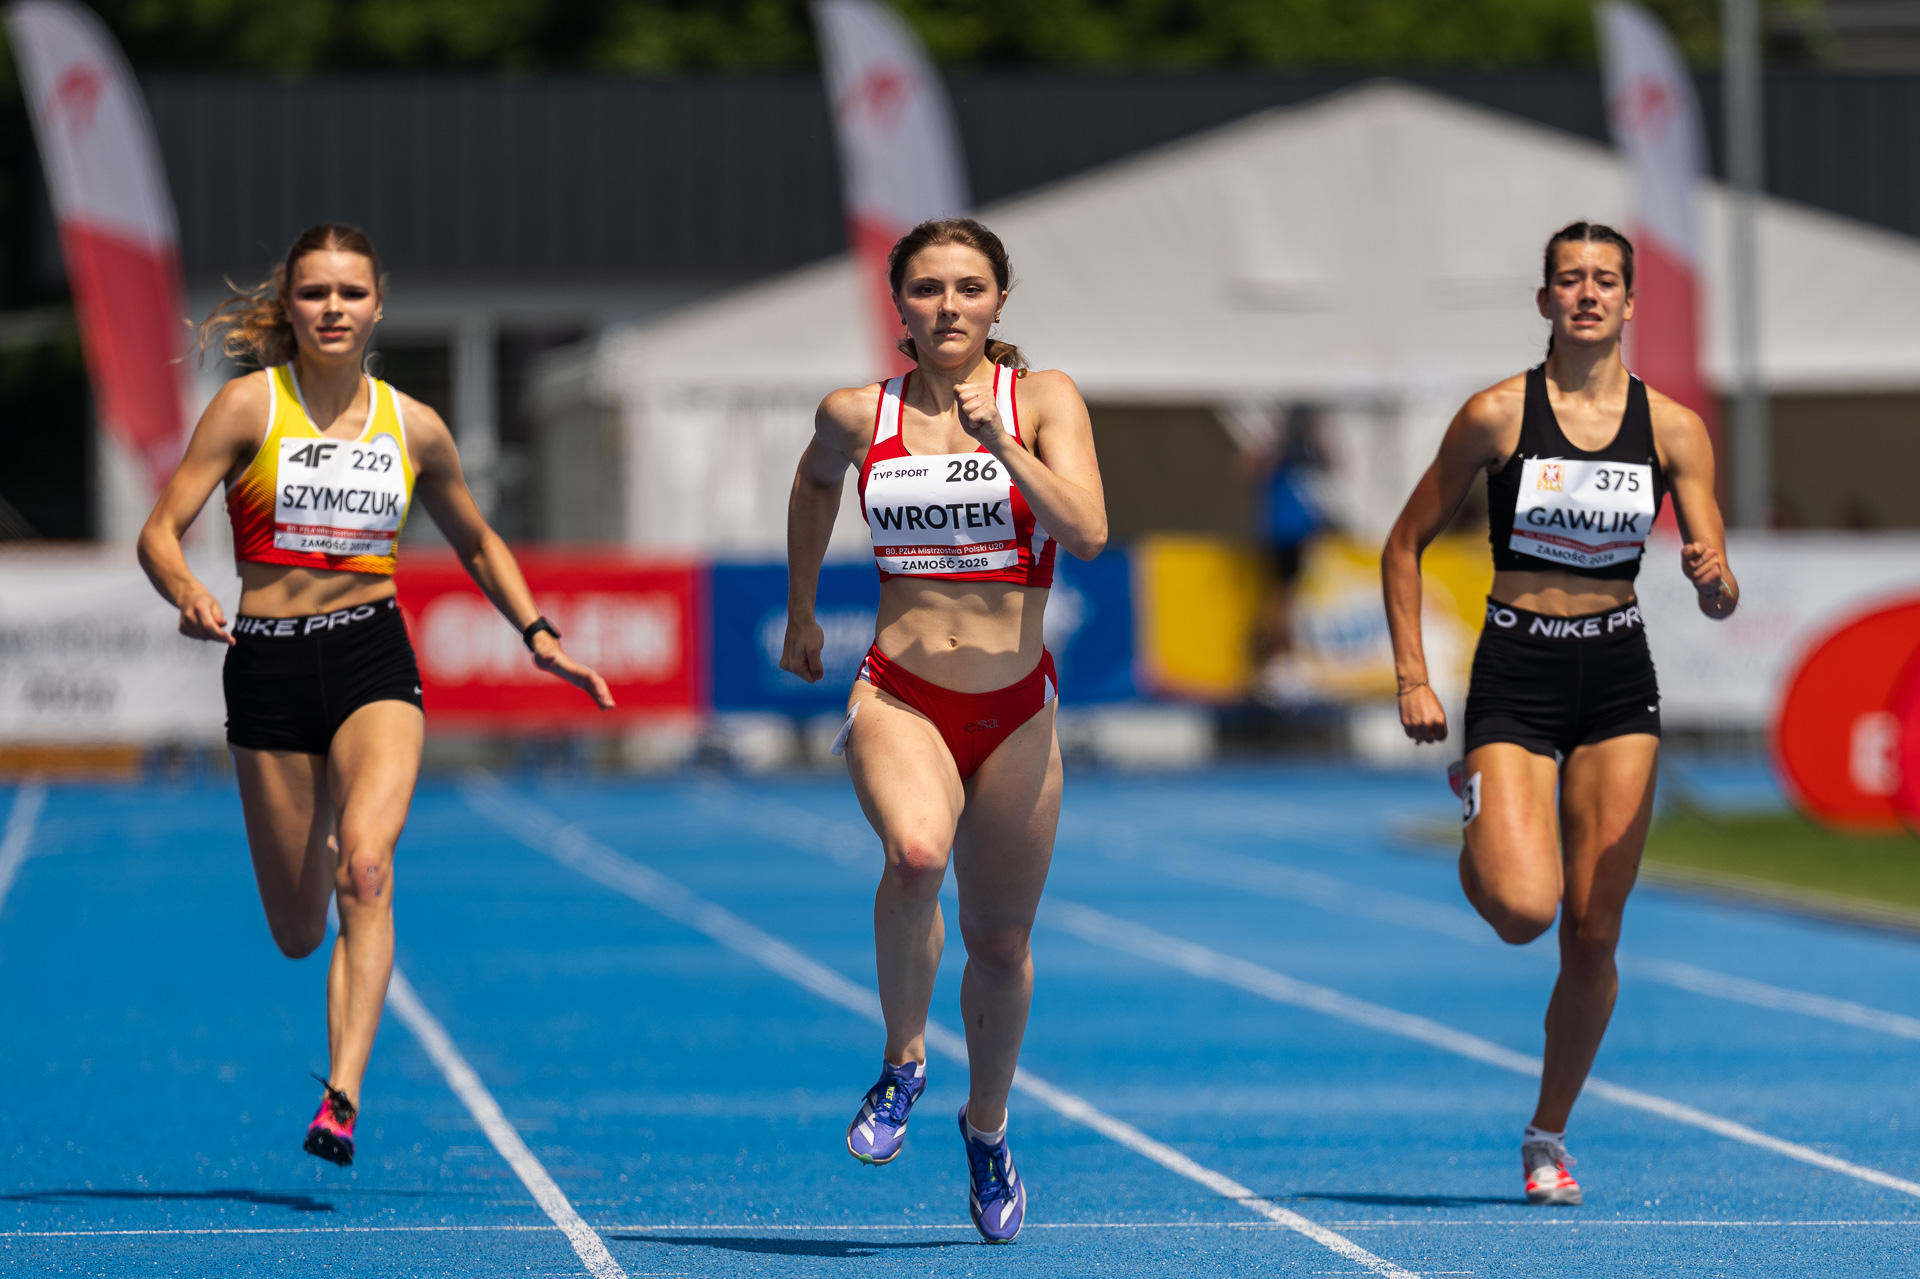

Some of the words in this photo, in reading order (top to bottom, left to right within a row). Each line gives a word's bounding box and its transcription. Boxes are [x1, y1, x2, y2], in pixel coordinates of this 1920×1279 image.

[288, 443, 338, 469] 4F
[352, 449, 393, 474] 229
[873, 471, 893, 481] TVP
[894, 468, 929, 478] SPORT
[945, 459, 998, 483] 286
[1595, 469, 1640, 492] 375
[282, 484, 400, 517] SZYMCZUK
[871, 502, 1006, 530] WROTEK
[1526, 506, 1641, 534] GAWLIK
[885, 547, 898, 555] 80.
[898, 547, 917, 555] PZLA
[917, 546, 963, 555] Mistrzostwa
[963, 545, 987, 554] Polski
[988, 542, 1004, 551] U20
[901, 557, 955, 570] ZAMOŚĆ
[957, 557, 989, 569] 2026
[235, 618, 299, 637] NIKE
[303, 604, 376, 636] PRO
[1487, 604, 1518, 629] RO
[1528, 616, 1602, 639] NIKE
[1606, 605, 1641, 634] PR
